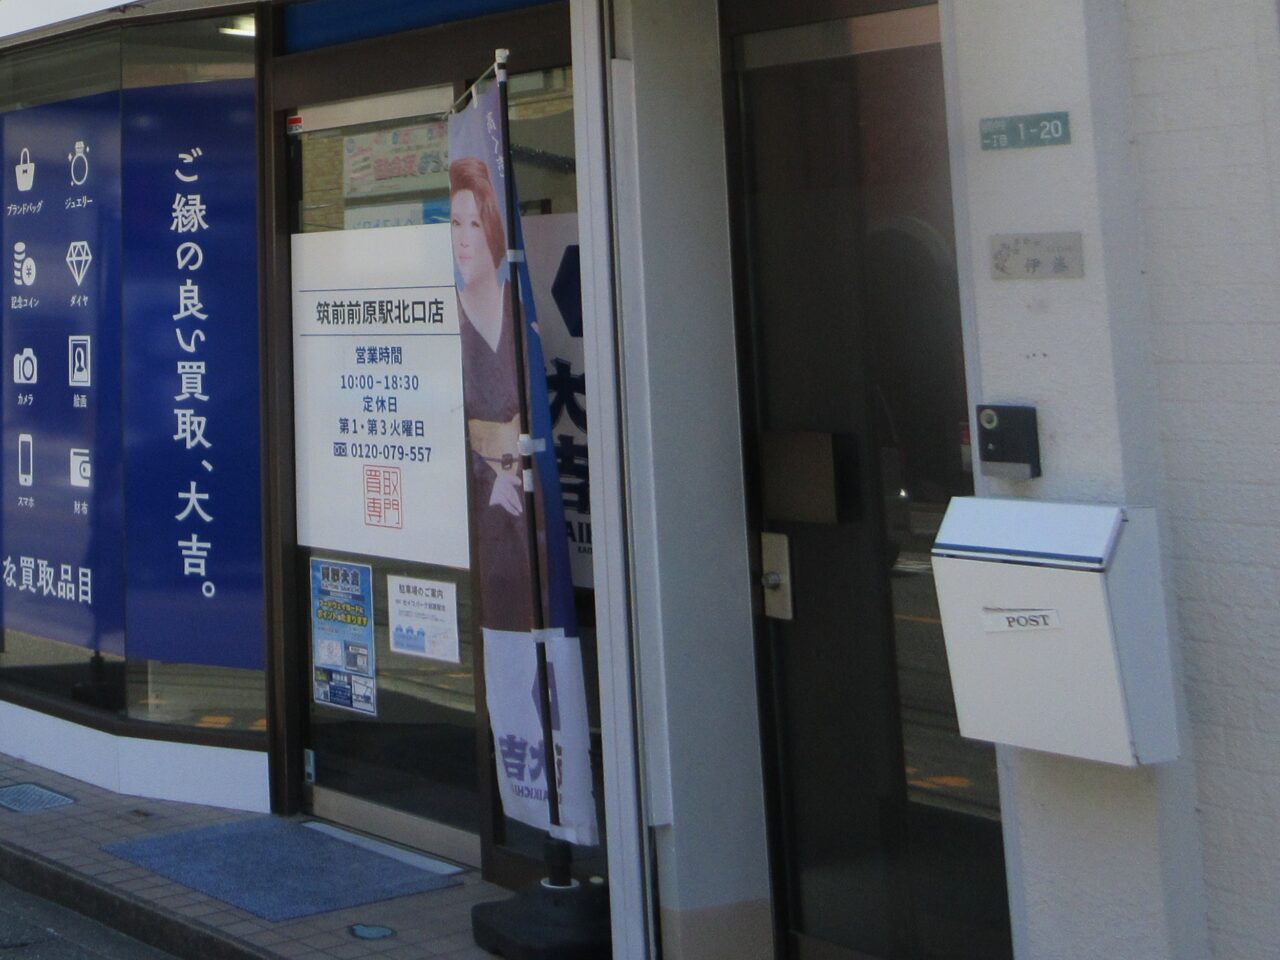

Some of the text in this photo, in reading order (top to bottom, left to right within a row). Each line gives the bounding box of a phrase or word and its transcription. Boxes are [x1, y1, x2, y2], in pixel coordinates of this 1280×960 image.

[7, 200, 44, 216] ブランドバッグ
[64, 196, 93, 210] ジュエリー
[10, 296, 40, 310] 記念コイン
[70, 294, 89, 308] ダイヤ
[316, 298, 445, 326] 筑前前原駅北口店
[355, 345, 403, 365] 営業時間
[170, 146, 216, 598] ご縁の良い買取、大吉。
[340, 374, 419, 391] 10:00-18:30
[17, 393, 35, 406] カメラ
[73, 392, 88, 409] 絵画
[362, 396, 398, 414] 定休日
[350, 443, 432, 463] 0120-079-557
[17, 495, 36, 509] スマホ
[73, 500, 89, 516] 財布
[1005, 614, 1049, 628] POST
